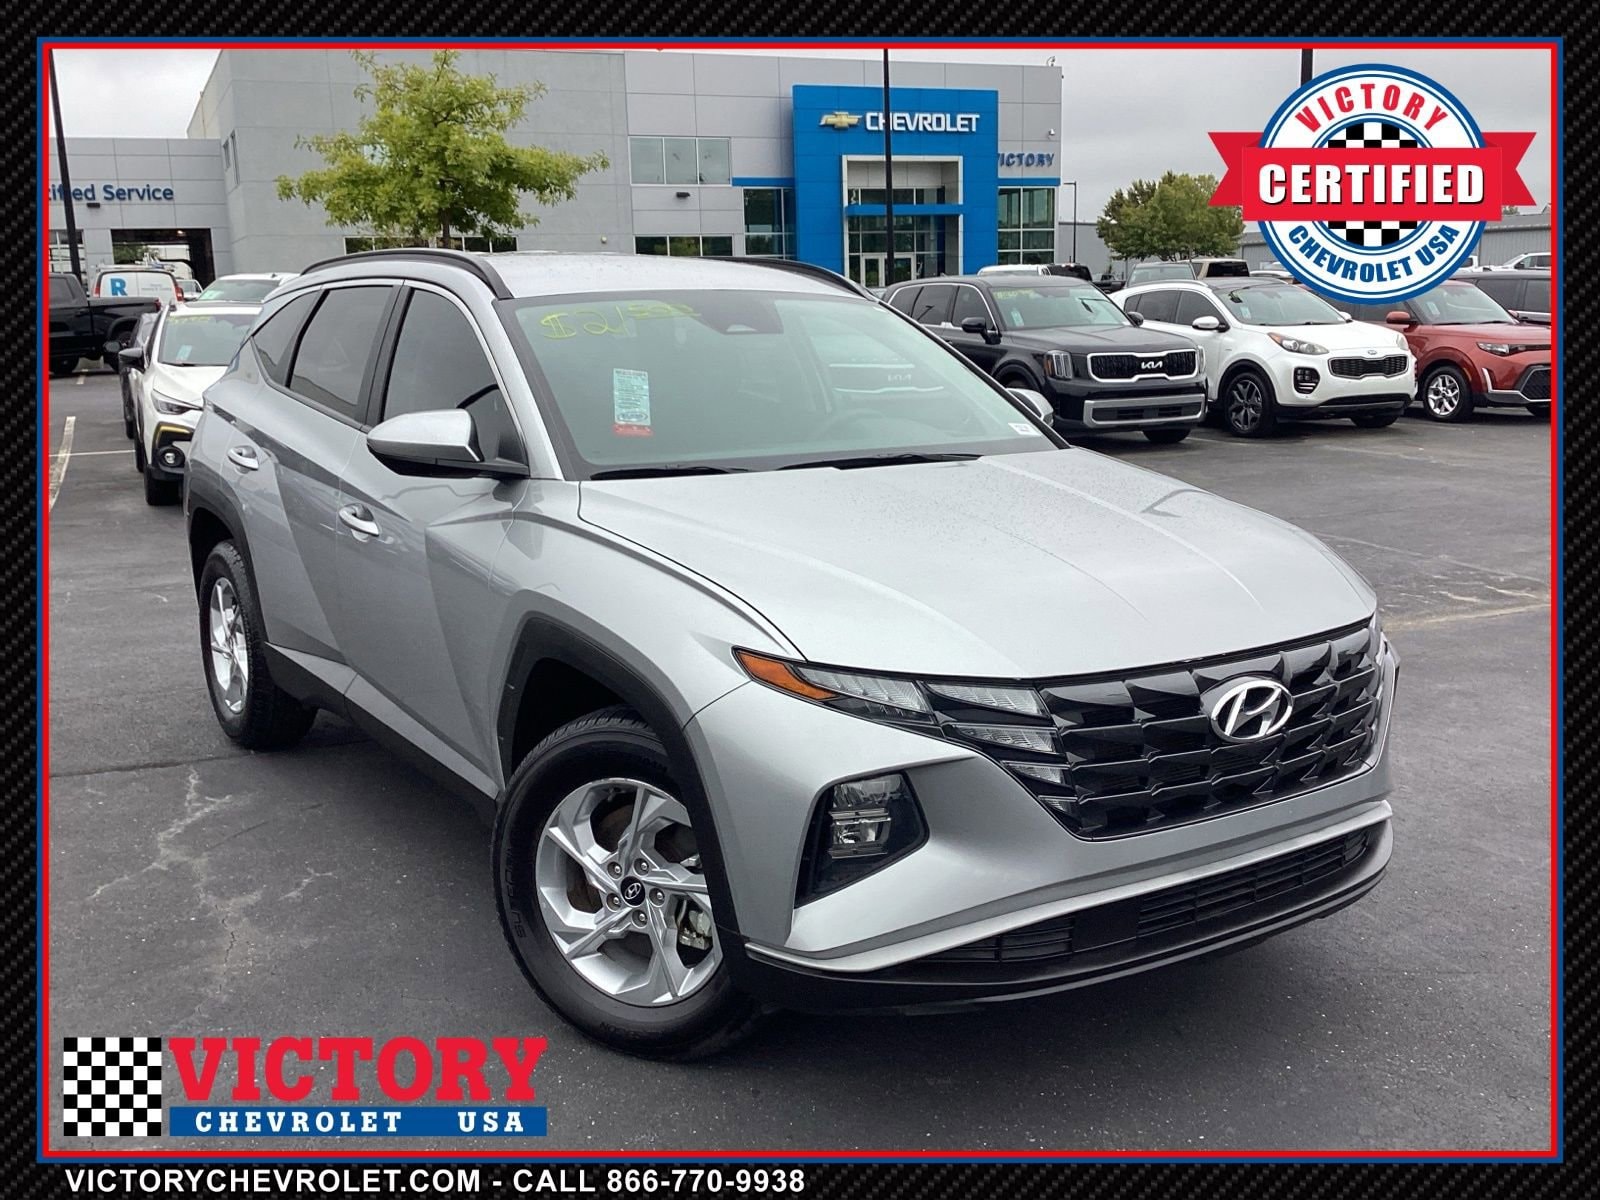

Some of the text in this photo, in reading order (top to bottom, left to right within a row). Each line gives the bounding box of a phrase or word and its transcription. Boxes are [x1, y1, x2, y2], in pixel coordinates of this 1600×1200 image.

[865, 112, 980, 132] CHEVROLET
[997, 153, 1055, 167] ICTORY
[102, 184, 174, 201] Service
[110, 278, 128, 296] R
